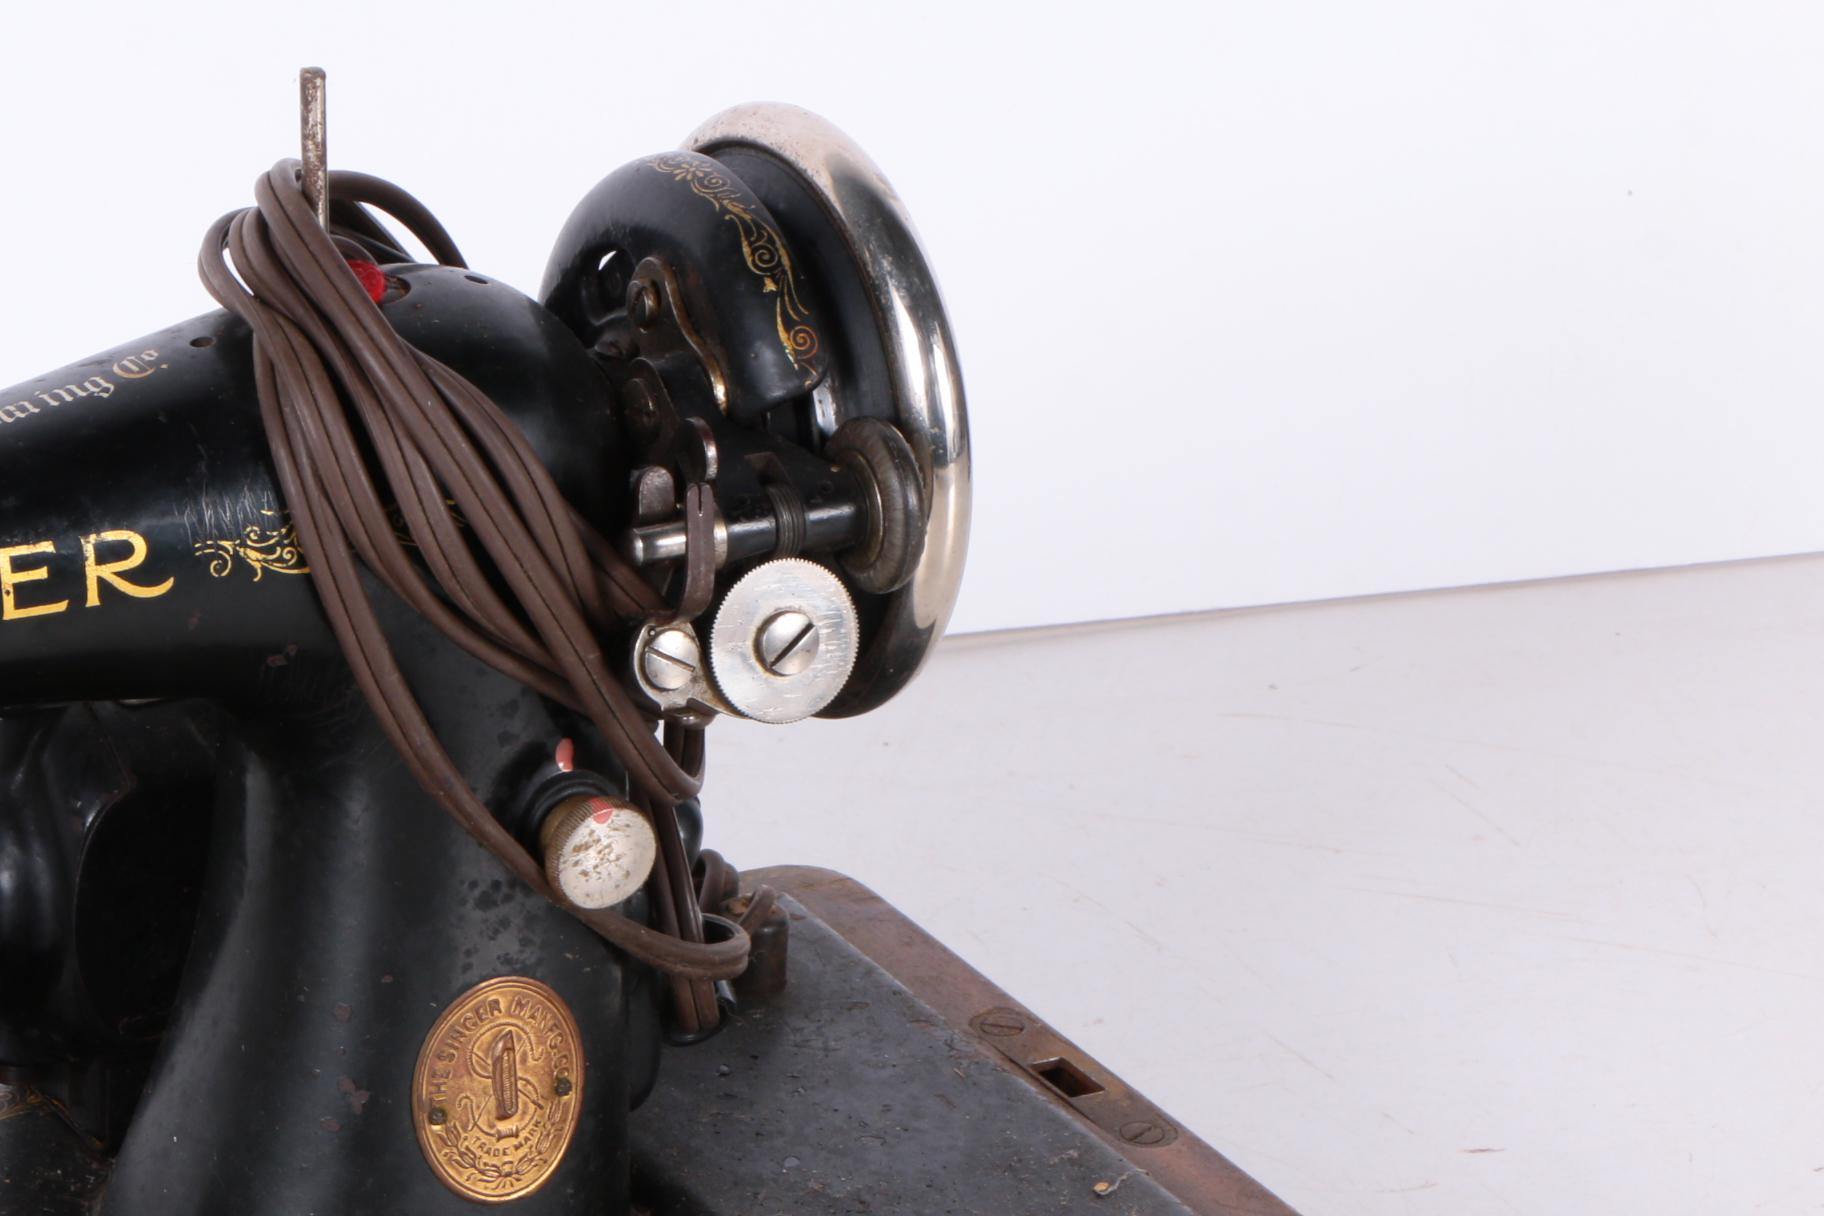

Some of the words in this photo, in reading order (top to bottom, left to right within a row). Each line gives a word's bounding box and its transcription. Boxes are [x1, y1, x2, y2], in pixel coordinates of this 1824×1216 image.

[437, 997, 502, 1065] SINGER
[473, 1134, 511, 1157] TRADE
[514, 1117, 543, 1151] MARK
